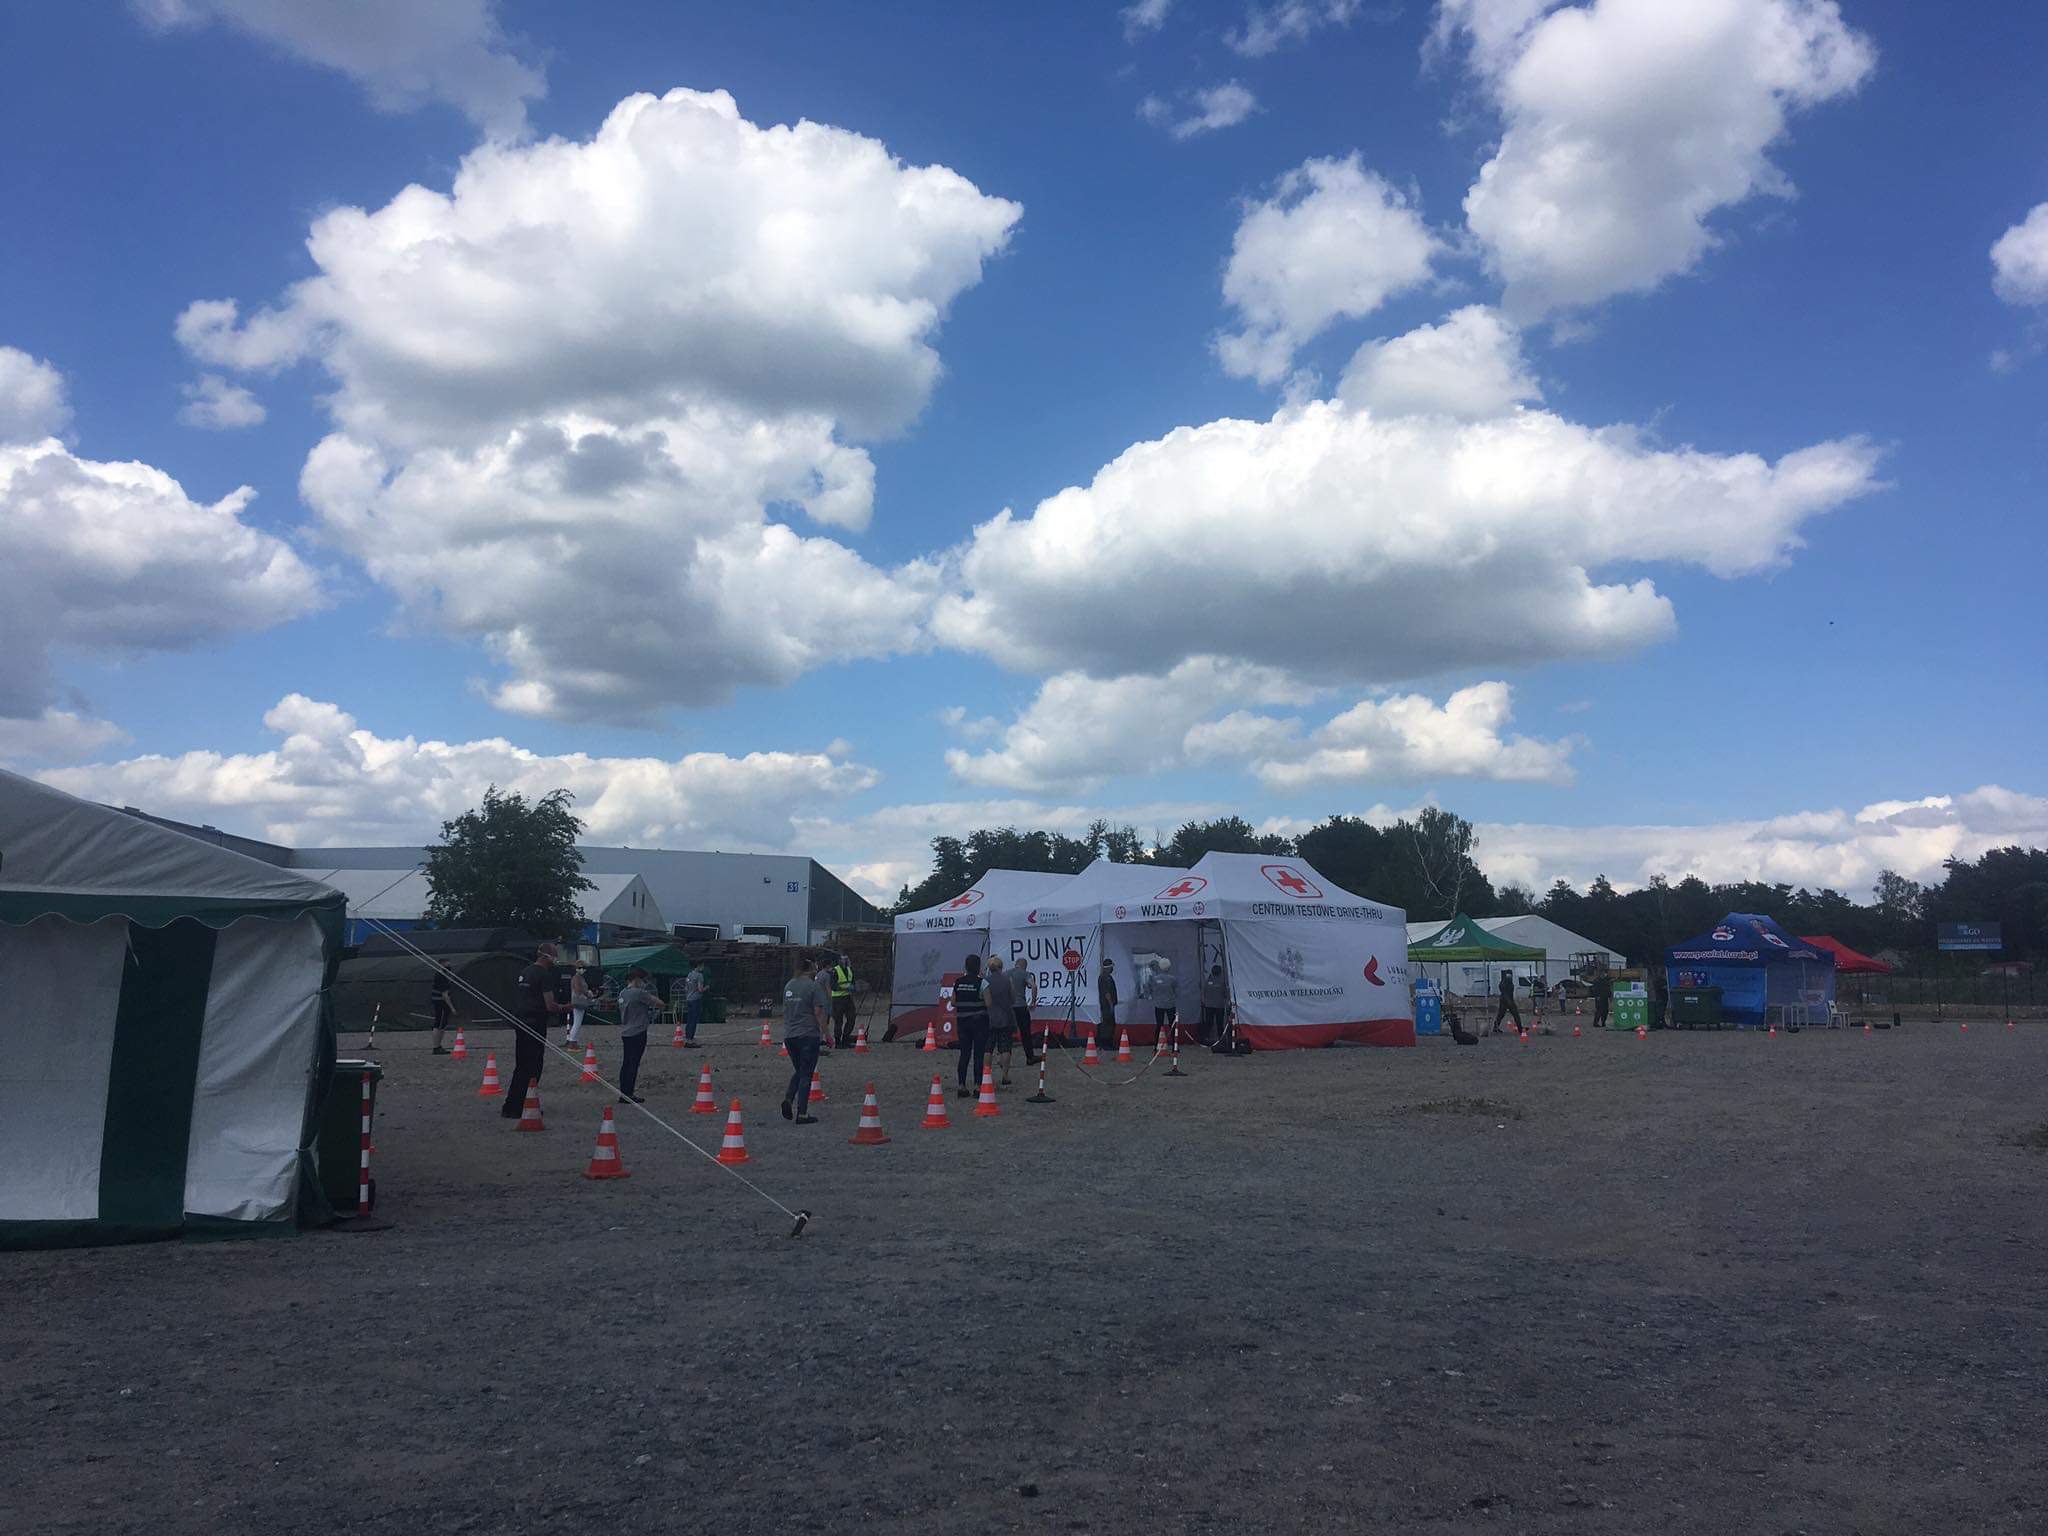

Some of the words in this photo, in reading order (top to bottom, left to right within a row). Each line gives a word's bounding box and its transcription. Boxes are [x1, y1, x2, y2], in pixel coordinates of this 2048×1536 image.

[788, 882, 799, 892] 31
[1141, 904, 1178, 917] WJAZD
[1252, 903, 1295, 916] CENTRUM
[1296, 904, 1336, 918] TESTOWE
[1337, 907, 1383, 920] DRIVE-THRU
[926, 917, 955, 928] WJAZD
[1010, 935, 1086, 961] PUNKT
[1064, 956, 1080, 964] STOP
[1248, 990, 1288, 1000] WOJEWODA
[1289, 987, 1344, 998] WIELKOPOLSKI
